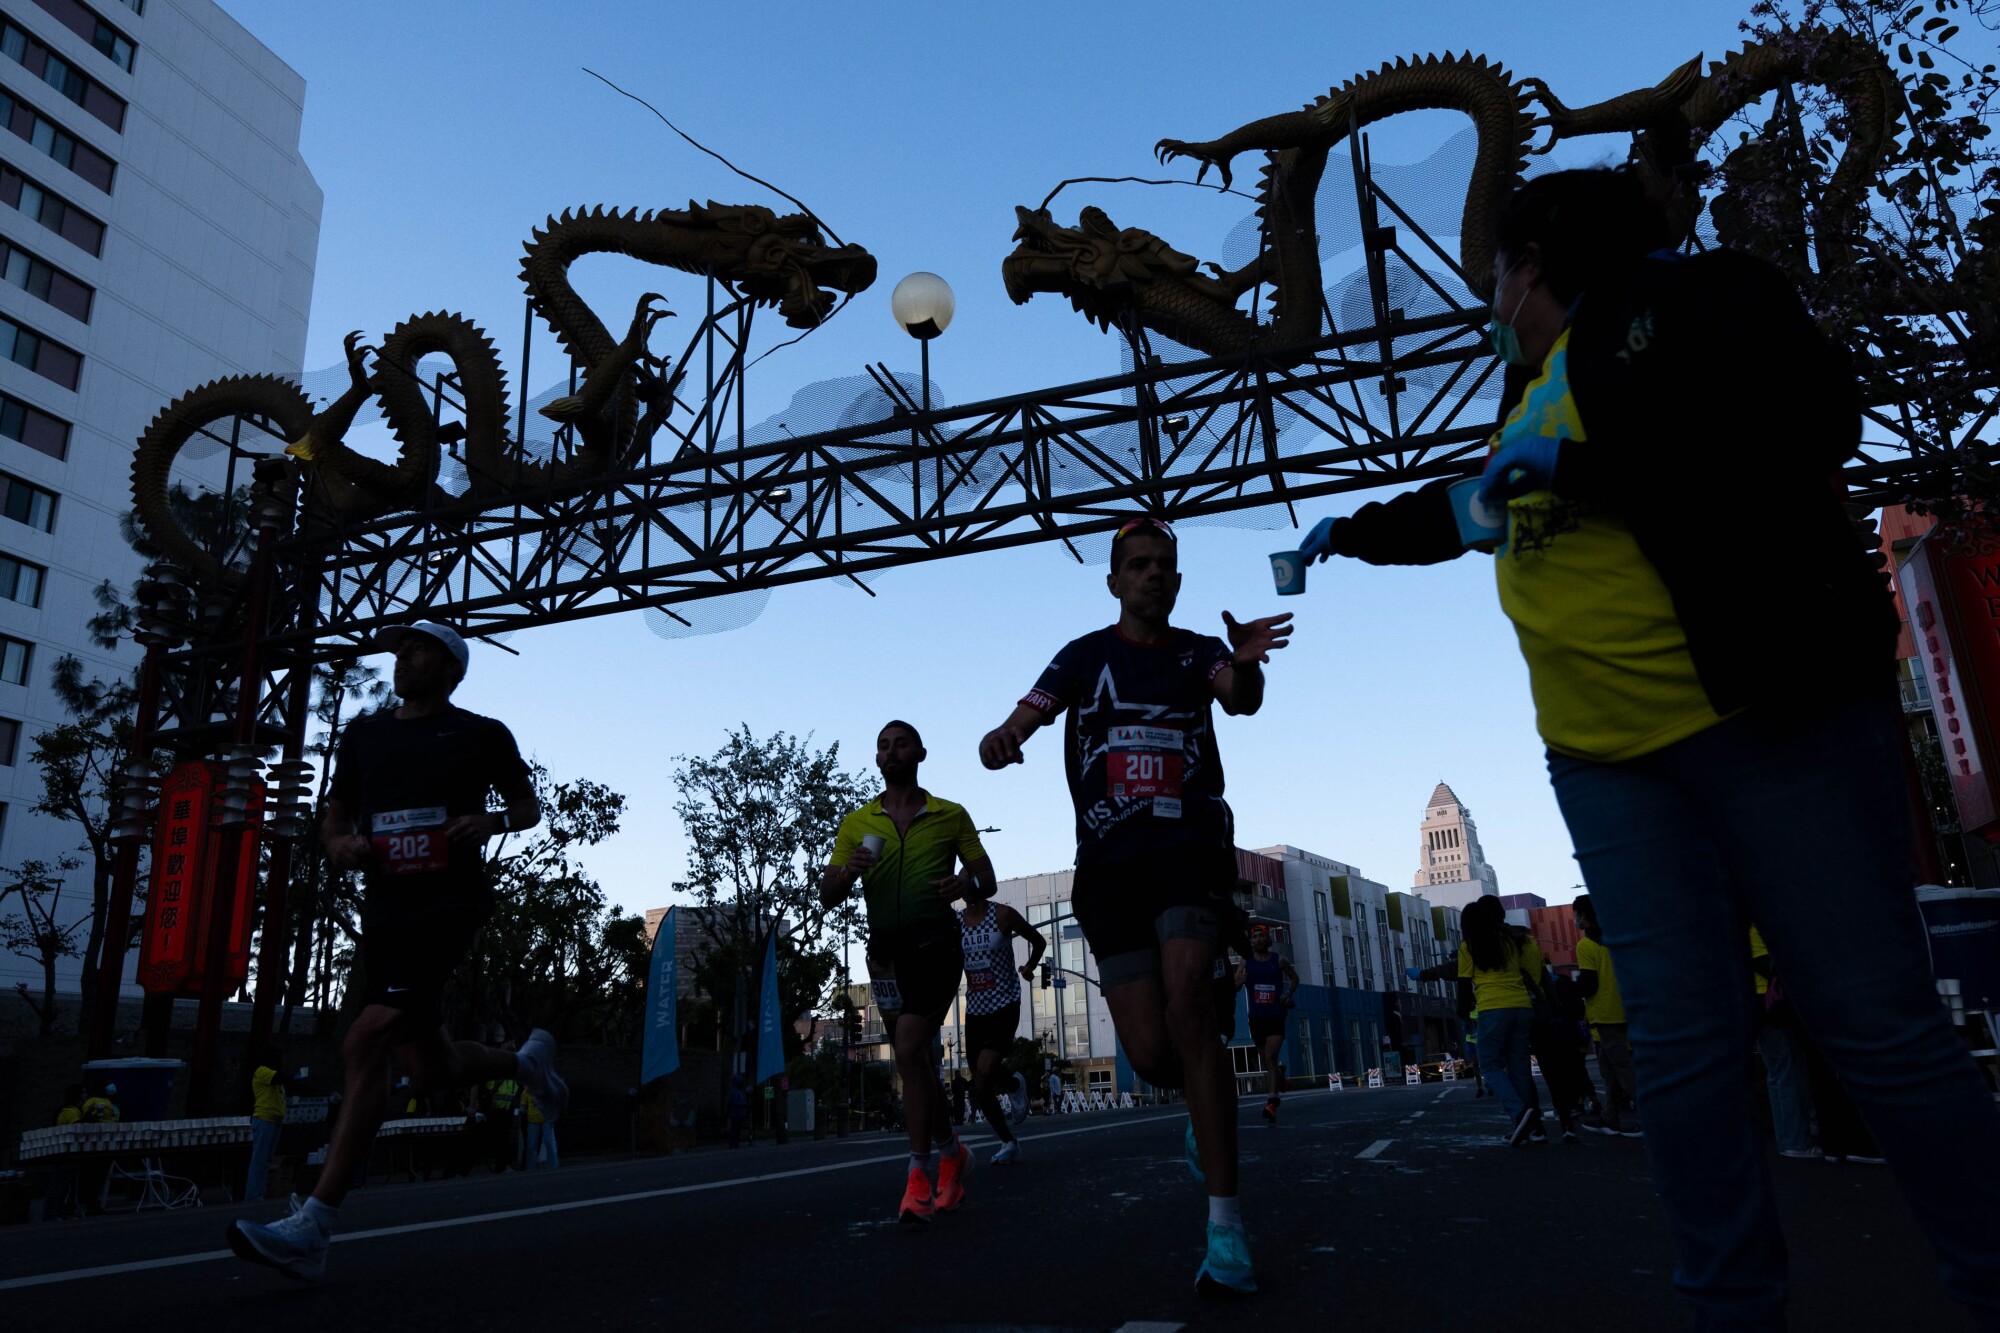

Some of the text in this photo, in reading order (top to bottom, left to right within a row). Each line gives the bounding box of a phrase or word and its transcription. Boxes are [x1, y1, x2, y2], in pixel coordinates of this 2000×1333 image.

[1024, 691, 1056, 711] TARY
[1126, 754, 1164, 780] 201
[1083, 799, 1112, 830] US
[389, 834, 431, 860] 202
[964, 934, 990, 946] ALOR
[970, 972, 986, 984] 222
[656, 960, 673, 1028] WATER
